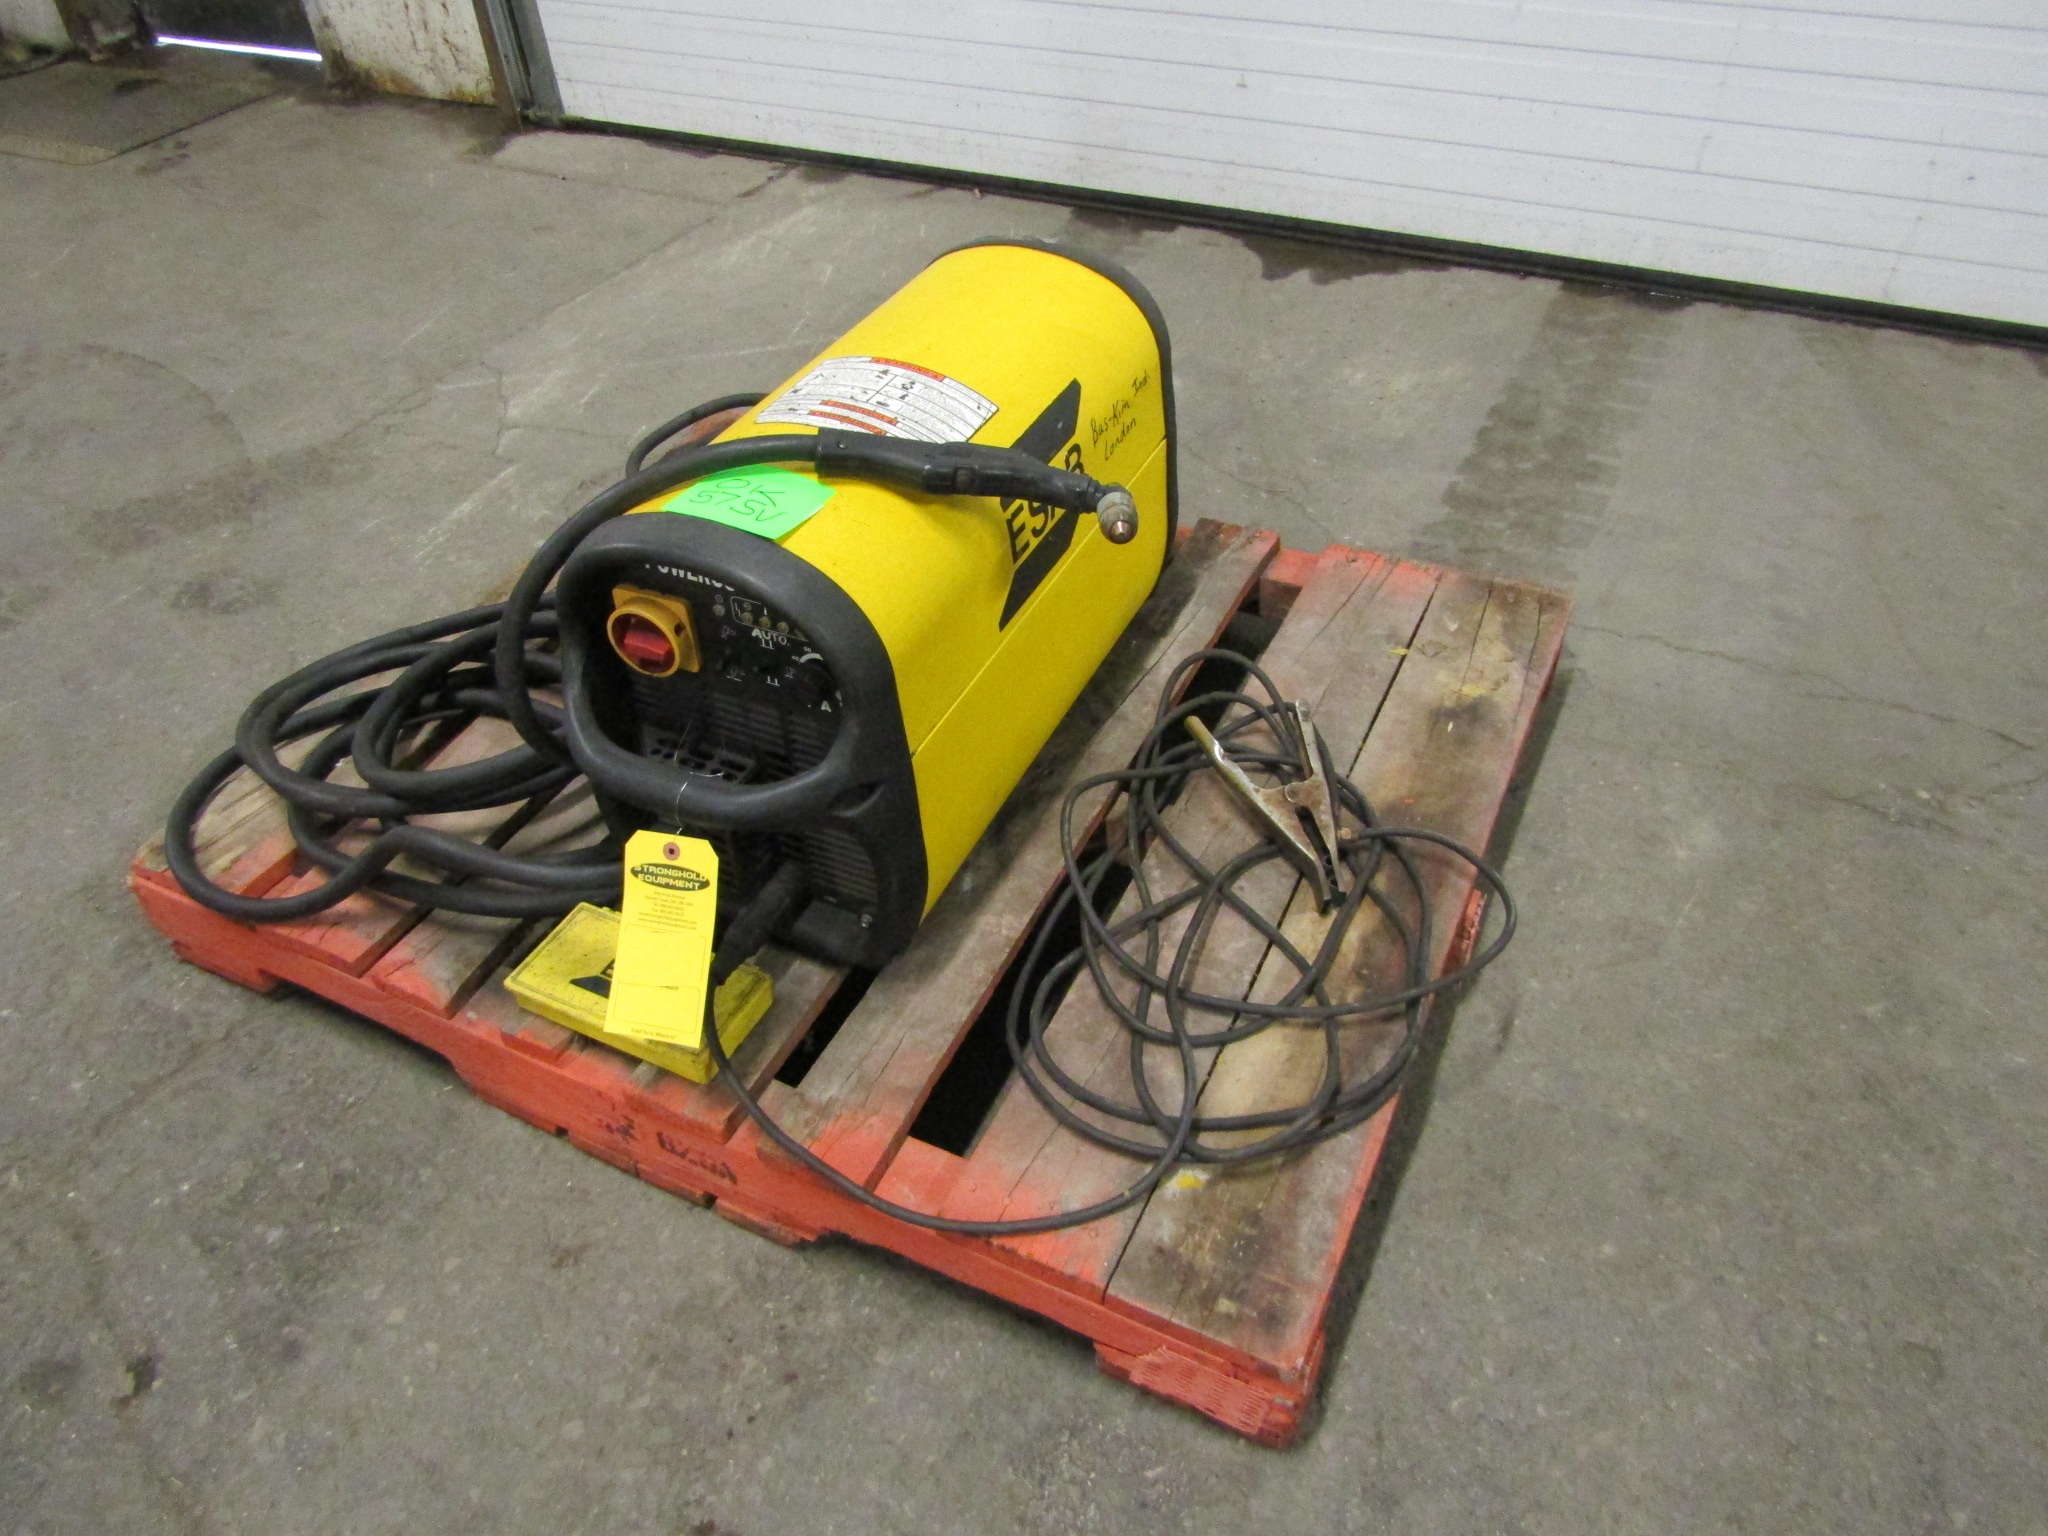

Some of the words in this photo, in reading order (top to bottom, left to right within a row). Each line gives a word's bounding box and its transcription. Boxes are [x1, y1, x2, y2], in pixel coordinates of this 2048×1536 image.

[1105, 418, 1137, 461] London
[717, 478, 786, 507] OK
[1006, 443, 1084, 565] ESB
[633, 864, 709, 882] STRONGHOLD
[638, 873, 703, 891] EQUIPMENT
